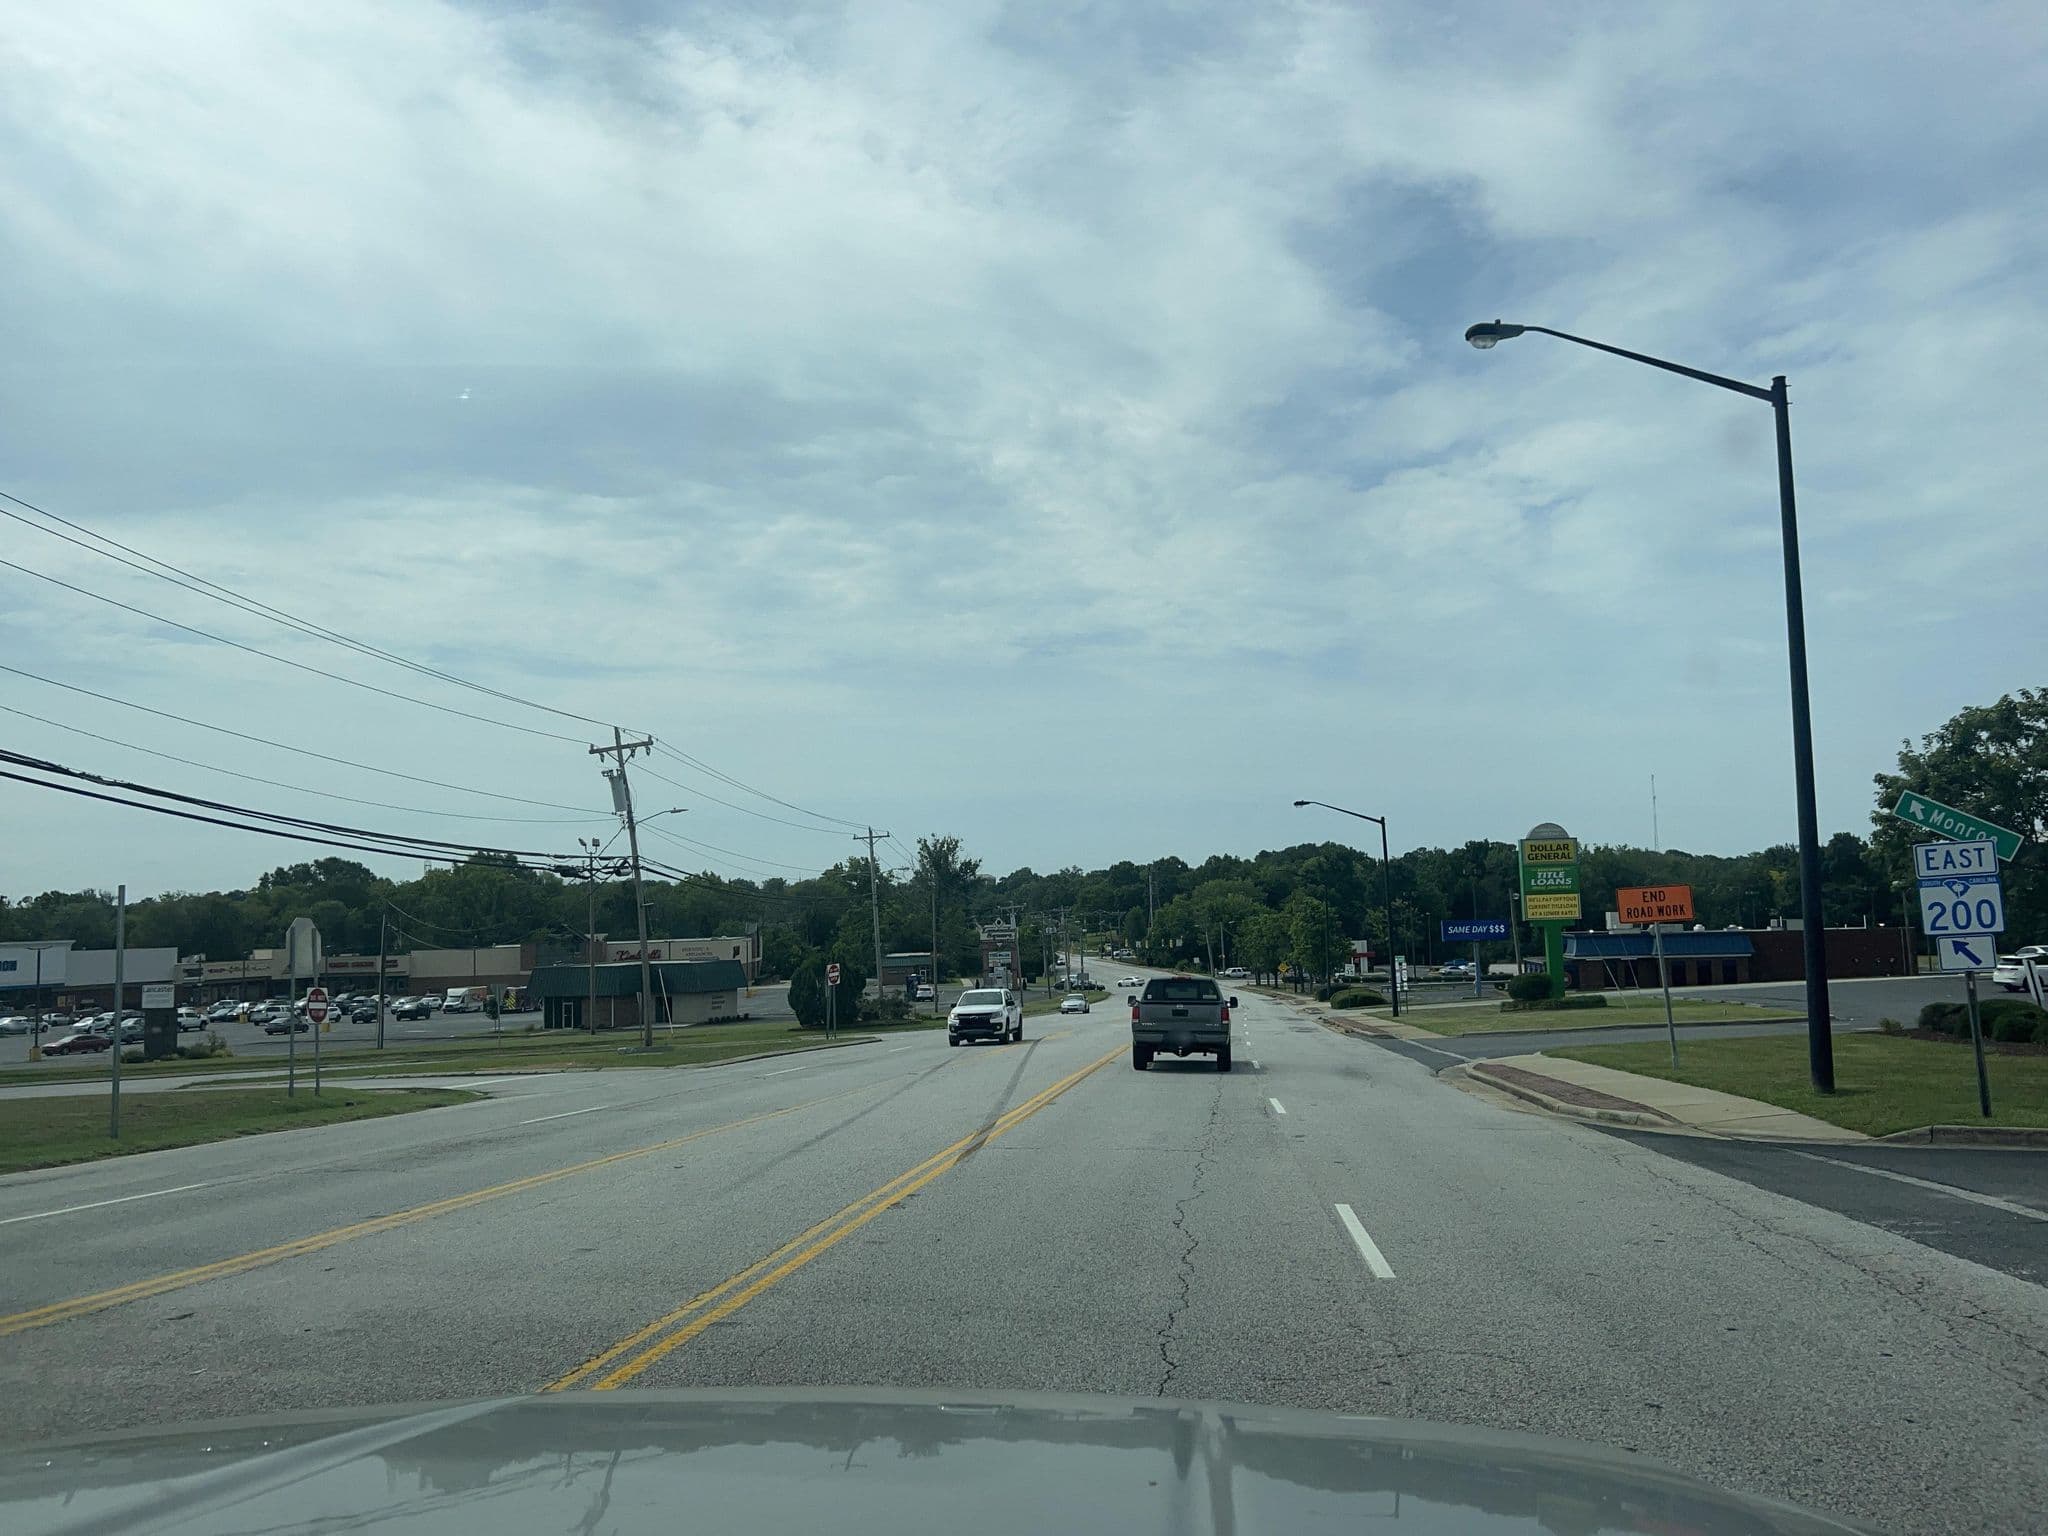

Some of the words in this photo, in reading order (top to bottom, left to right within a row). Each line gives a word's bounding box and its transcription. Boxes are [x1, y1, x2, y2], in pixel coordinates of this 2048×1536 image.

[1530, 844, 1570, 852] DOLLAR
[1528, 852, 1573, 861] GENERAL
[1924, 847, 1985, 871] EAST
[1531, 878, 1573, 886] LOANS
[1642, 890, 1666, 903] END
[1626, 906, 1653, 919] ROAD
[1657, 904, 1686, 917] WORK
[1928, 899, 1997, 931] 200
[1448, 926, 1471, 934] SAME
[1472, 925, 1488, 933] DAY
[1489, 924, 1505, 933] $$$
